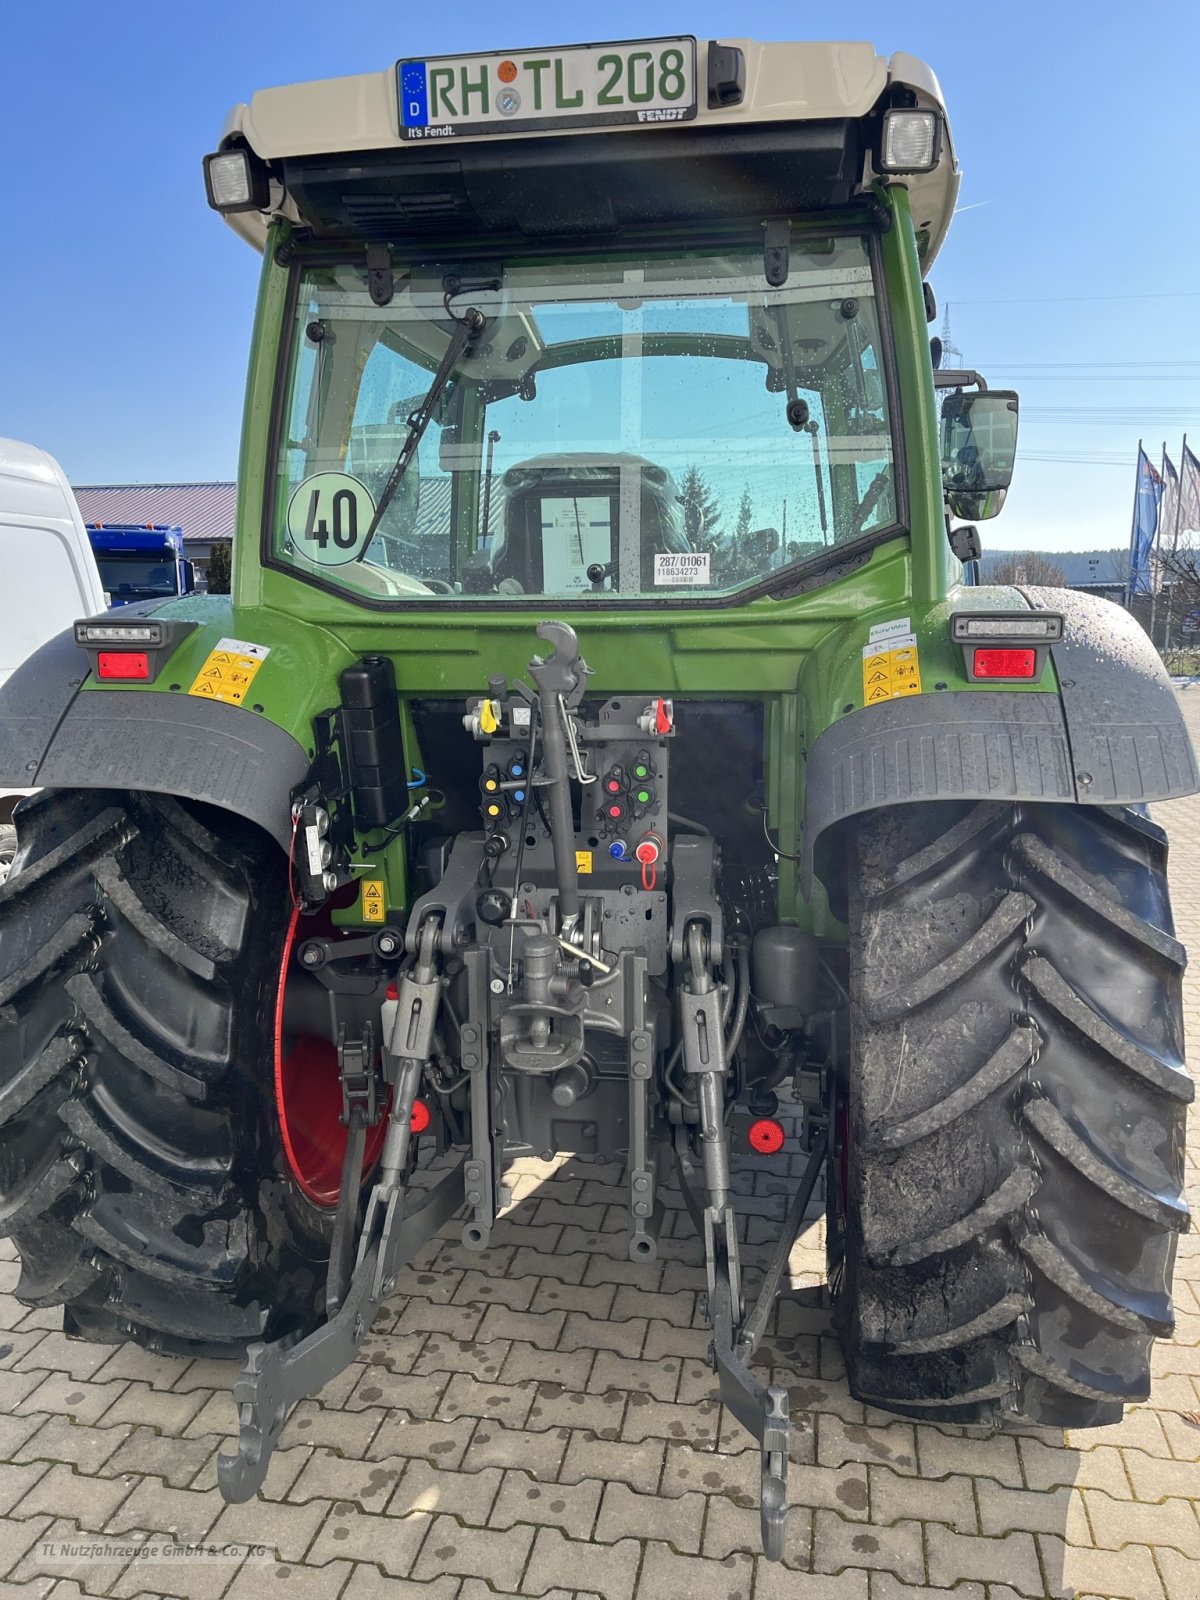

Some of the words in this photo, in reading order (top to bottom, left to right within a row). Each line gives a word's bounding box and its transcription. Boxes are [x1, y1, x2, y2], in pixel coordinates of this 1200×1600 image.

[430, 64, 489, 117] RH
[523, 59, 583, 110] TL
[597, 49, 686, 106] 208
[410, 102, 420, 116] D
[637, 108, 687, 122] FENDT
[408, 126, 422, 138] It's
[424, 125, 455, 137] Fendt.
[304, 489, 358, 549] 40
[657, 567, 698, 576] 118634273
